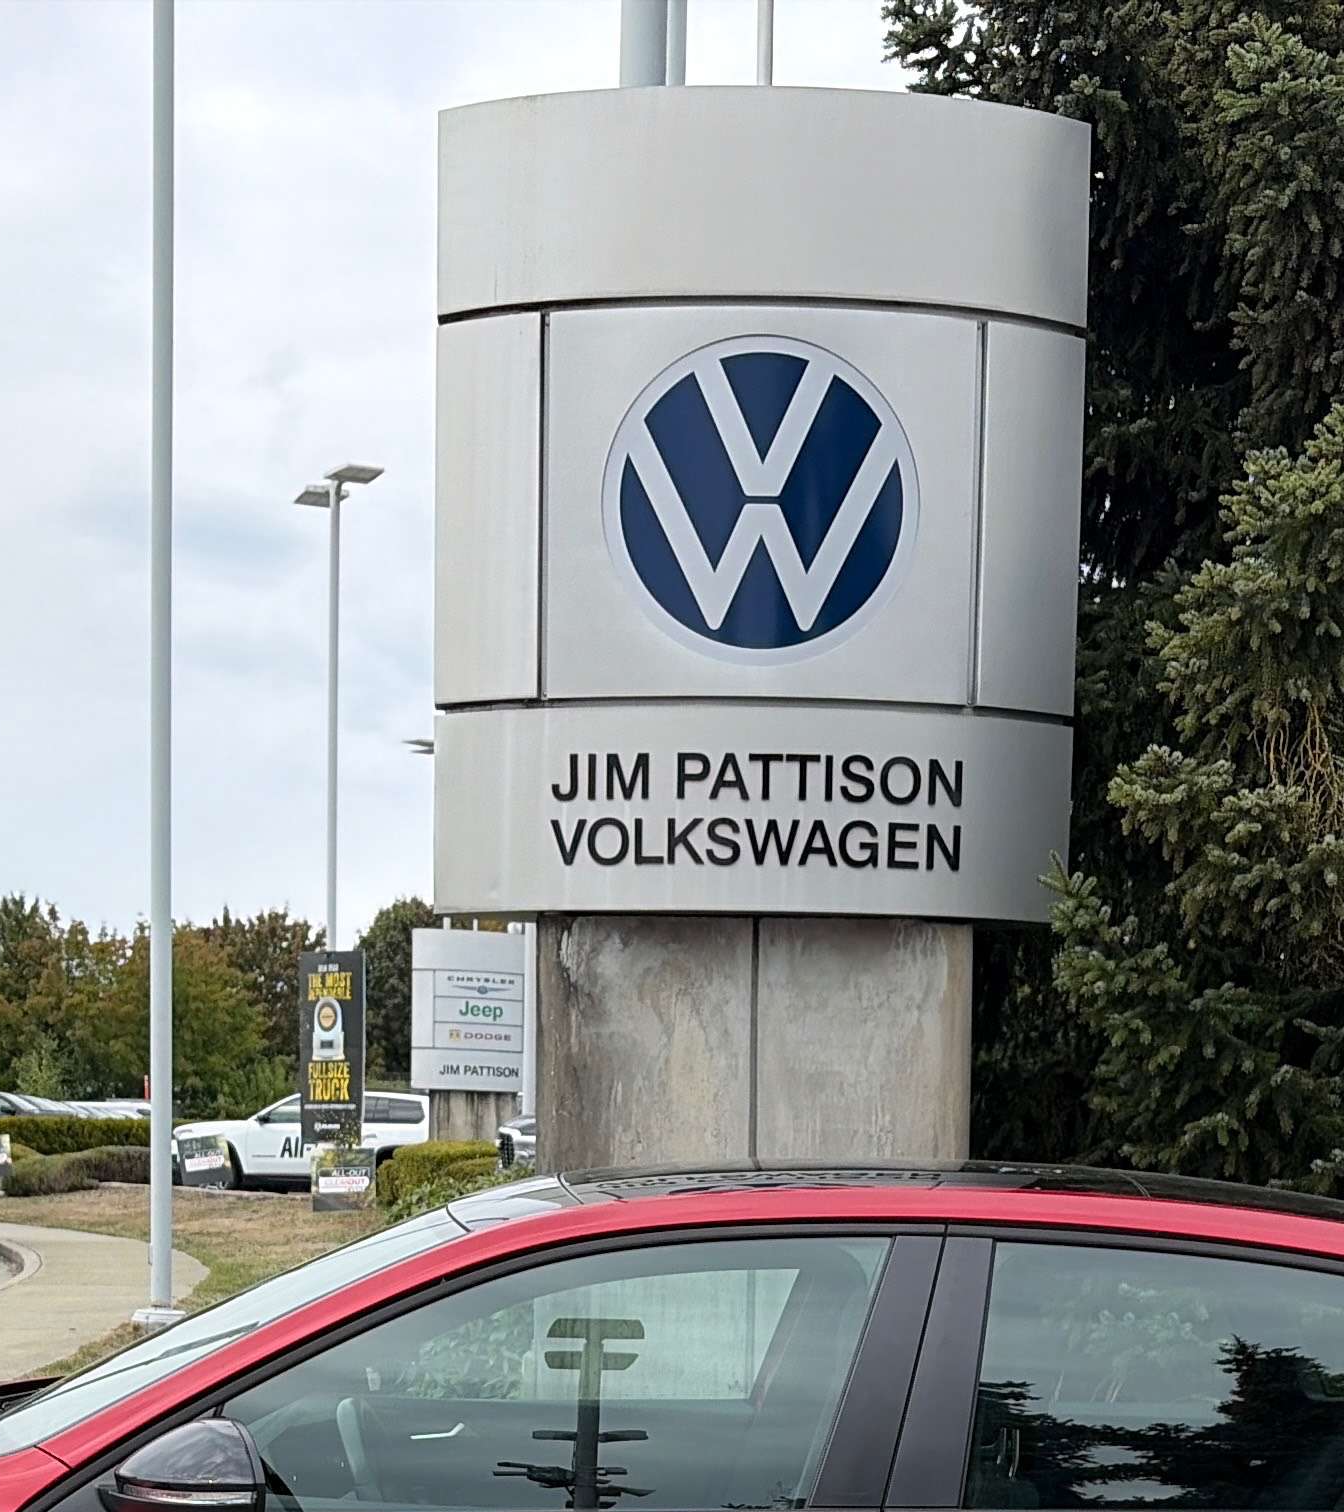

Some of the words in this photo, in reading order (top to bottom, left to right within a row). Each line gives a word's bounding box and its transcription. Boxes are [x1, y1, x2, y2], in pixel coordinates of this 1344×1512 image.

[619, 351, 904, 650] VW
[551, 752, 650, 802] JIM
[676, 752, 964, 808] PATTISON
[550, 817, 963, 873] VOLKSWAGEN
[447, 976, 515, 985] CHRYSLER
[459, 1000, 504, 1022] Jeep
[463, 1032, 511, 1042] DODGE
[308, 1061, 351, 1078] FULLSIZE
[439, 1064, 461, 1076] JIM
[463, 1065, 520, 1078] PATTISON
[308, 1079, 350, 1101] TRUCK
[331, 1168, 368, 1177] ALL-OUT
